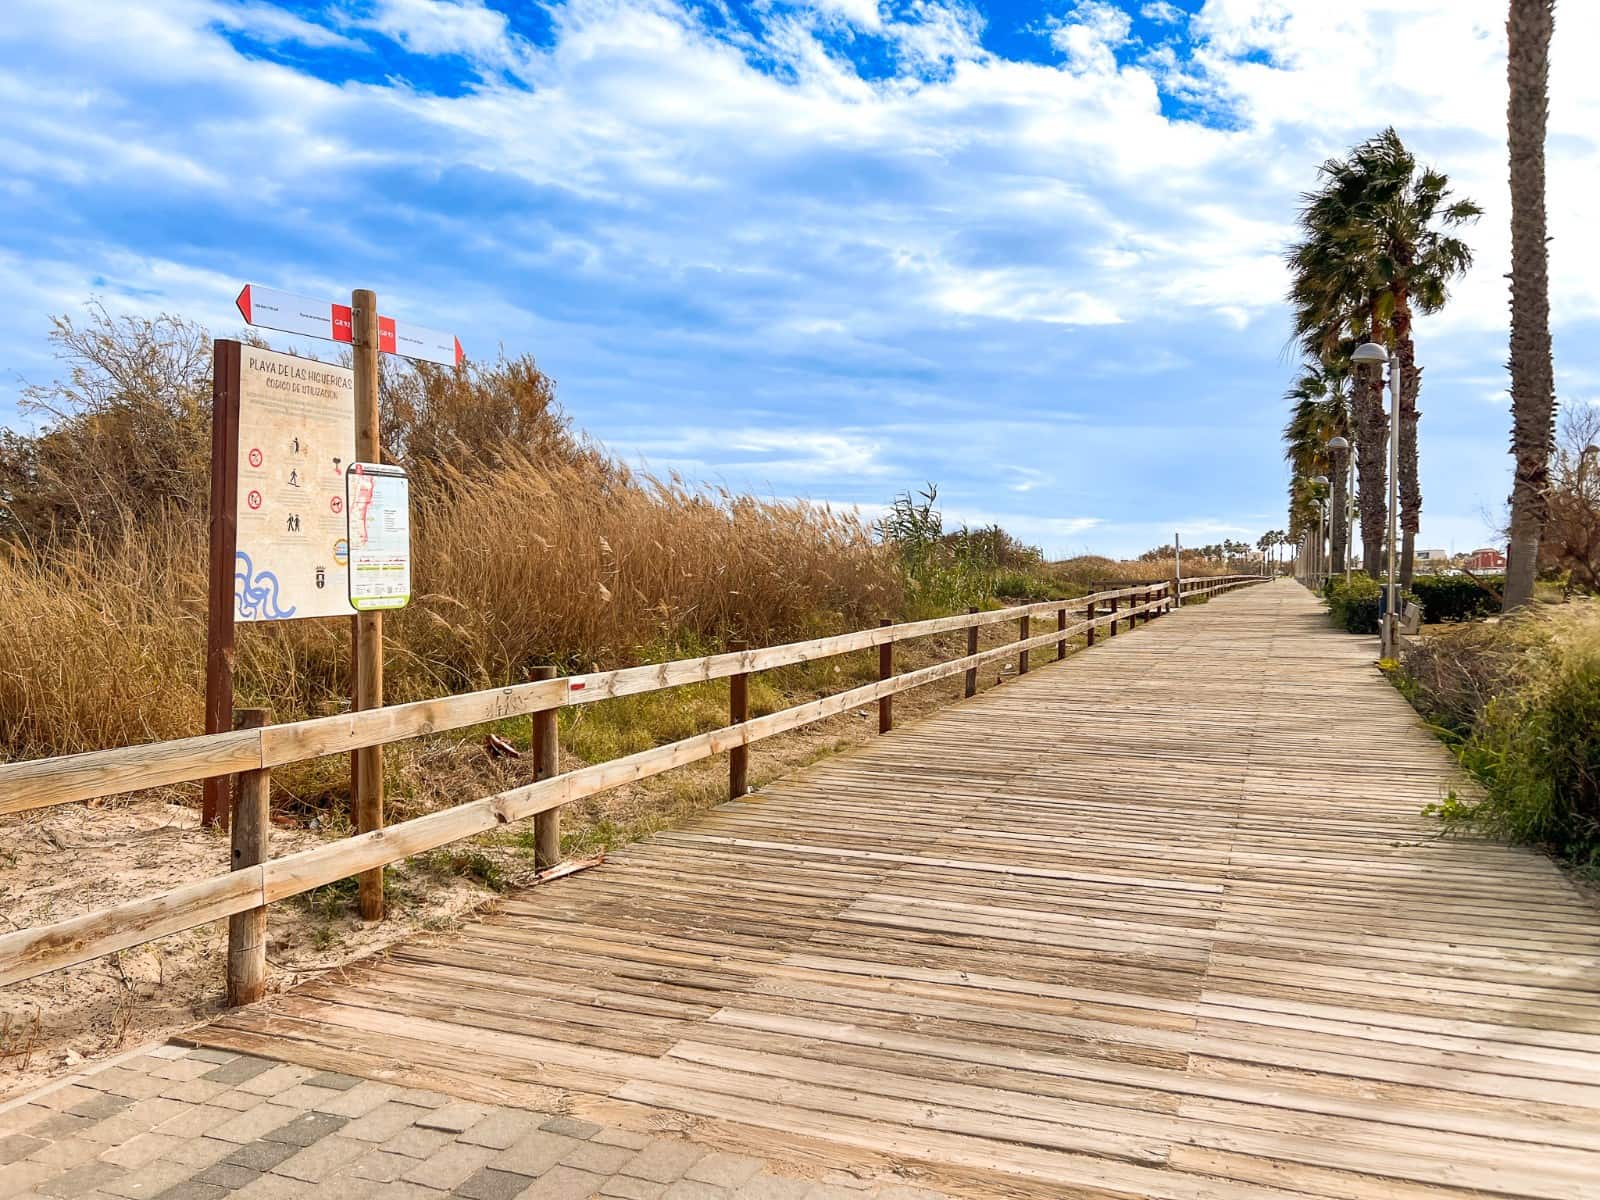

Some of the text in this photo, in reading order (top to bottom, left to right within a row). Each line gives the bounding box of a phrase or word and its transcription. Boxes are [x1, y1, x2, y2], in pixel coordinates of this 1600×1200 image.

[334, 319, 343, 327] GR
[249, 357, 352, 390] PLAYA DE LAS HIGUERICAS
[292, 383, 301, 394] DE
